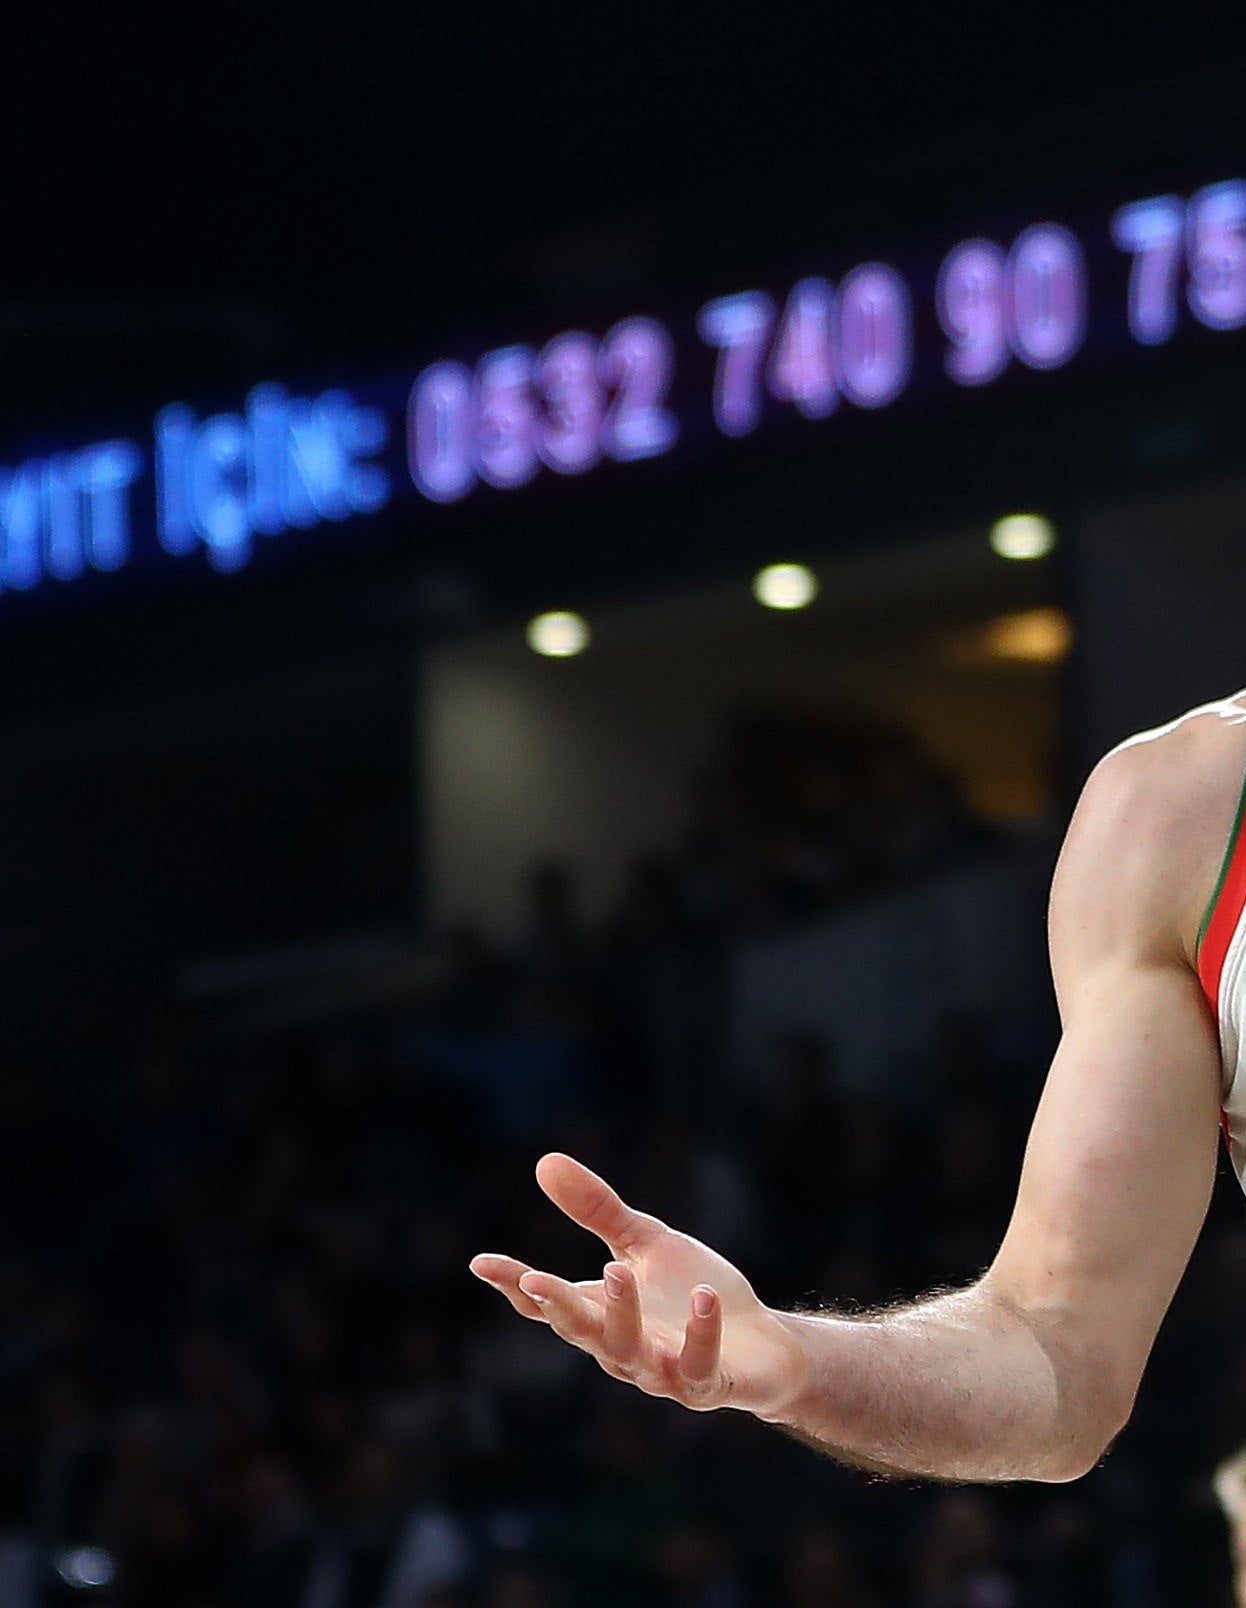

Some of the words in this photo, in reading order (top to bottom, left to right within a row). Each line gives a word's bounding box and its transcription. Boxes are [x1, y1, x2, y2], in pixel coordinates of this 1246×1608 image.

[407, 315, 679, 504] 0532
[697, 262, 913, 438] 740
[937, 222, 1088, 386] 90
